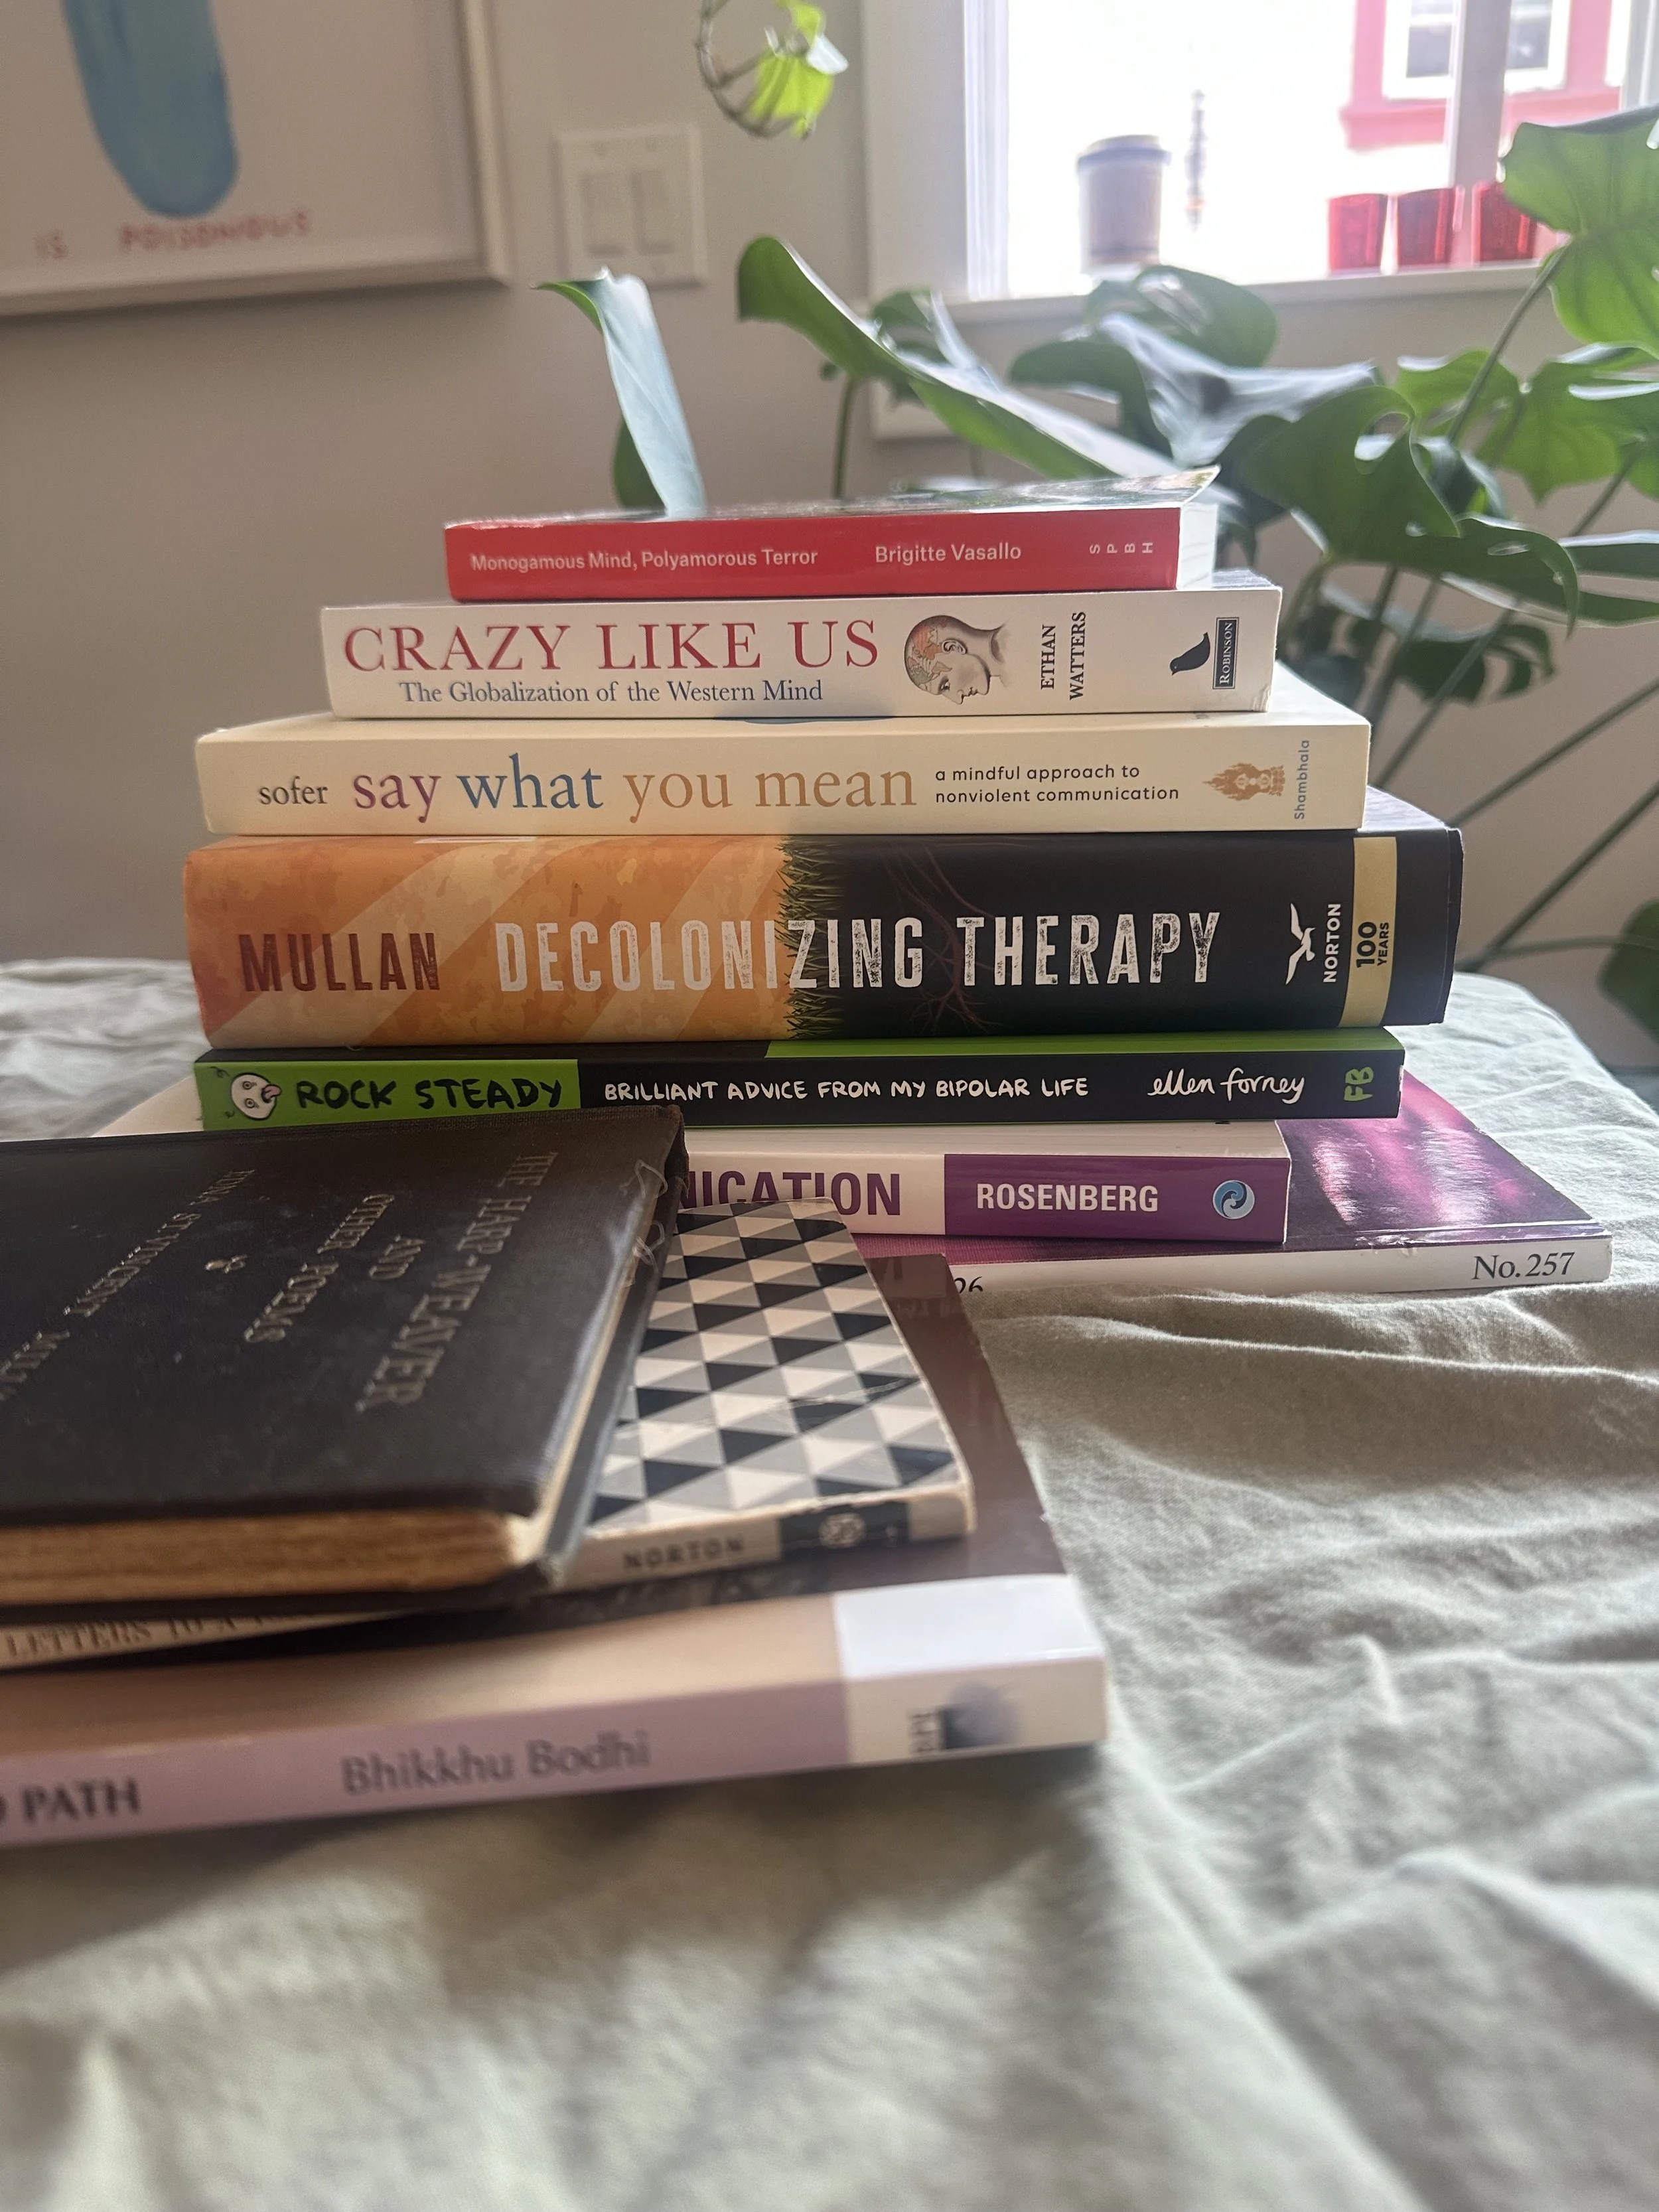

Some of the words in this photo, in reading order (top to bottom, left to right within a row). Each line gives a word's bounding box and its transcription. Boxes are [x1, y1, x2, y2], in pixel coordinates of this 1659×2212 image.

[472, 553, 585, 573] Monogamous
[589, 552, 638, 570] Mind,
[642, 550, 757, 569] Polyamorous
[762, 549, 818, 565] Terror
[875, 544, 946, 565] Brigitte
[952, 542, 1021, 561] Vasallo
[344, 625, 571, 672] CRAZY
[599, 622, 761, 670] LIKE
[788, 619, 878, 668] US
[1041, 625, 1056, 690] ETHAN
[1069, 611, 1086, 701] WATTERS
[399, 681, 442, 702] The
[449, 681, 589, 702] Globalization
[597, 681, 618, 701] of
[627, 681, 660, 701] the
[667, 681, 755, 701] Western
[762, 679, 823, 701] Mind
[259, 775, 328, 805] sofer
[353, 773, 441, 823] say
[457, 752, 604, 809] what
[622, 773, 733, 824] you
[755, 769, 917, 808] mean
[935, 770, 946, 782] a
[952, 765, 1021, 781] mindful
[1027, 764, 1116, 782] approach
[1121, 765, 1140, 778] to
[935, 788, 1031, 804] nonviolent
[1037, 786, 1179, 802] communication
[1294, 739, 1310, 820] Shambhala
[238, 932, 441, 992] MULLAN
[495, 917, 924, 992] DECOLONIZING
[956, 911, 1220, 986] THERAPY
[1323, 903, 1342, 984] NORTON
[1356, 921, 1378, 968] 100
[1377, 922, 1390, 967] YEARS
[296, 1079, 397, 1110] ROCK
[413, 1078, 563, 1110] STEADY
[604, 1081, 719, 1101] BRILLIANT
[727, 1080, 808, 1100] ADVICE
[818, 1079, 881, 1098] FROM
[890, 1079, 926, 1099] MY
[935, 1078, 1031, 1098] BIPOLAR
[1040, 1077, 1089, 1097] LIFE
[1147, 1067, 1216, 1096] ellen
[1219, 1067, 1305, 1104] forney
[498, 1151, 558, 1187] THE
[976, 1183, 1159, 1213] ROSENBERG
[317, 1194, 394, 1254] OTHER
[244, 1262, 339, 1343] POEMS
[622, 1534, 745, 1572] NORTON
[340, 1741, 515, 1795] Bhikkhu
[526, 1728, 651, 1777] Bodhi
[20, 1775, 141, 1825] PATH
